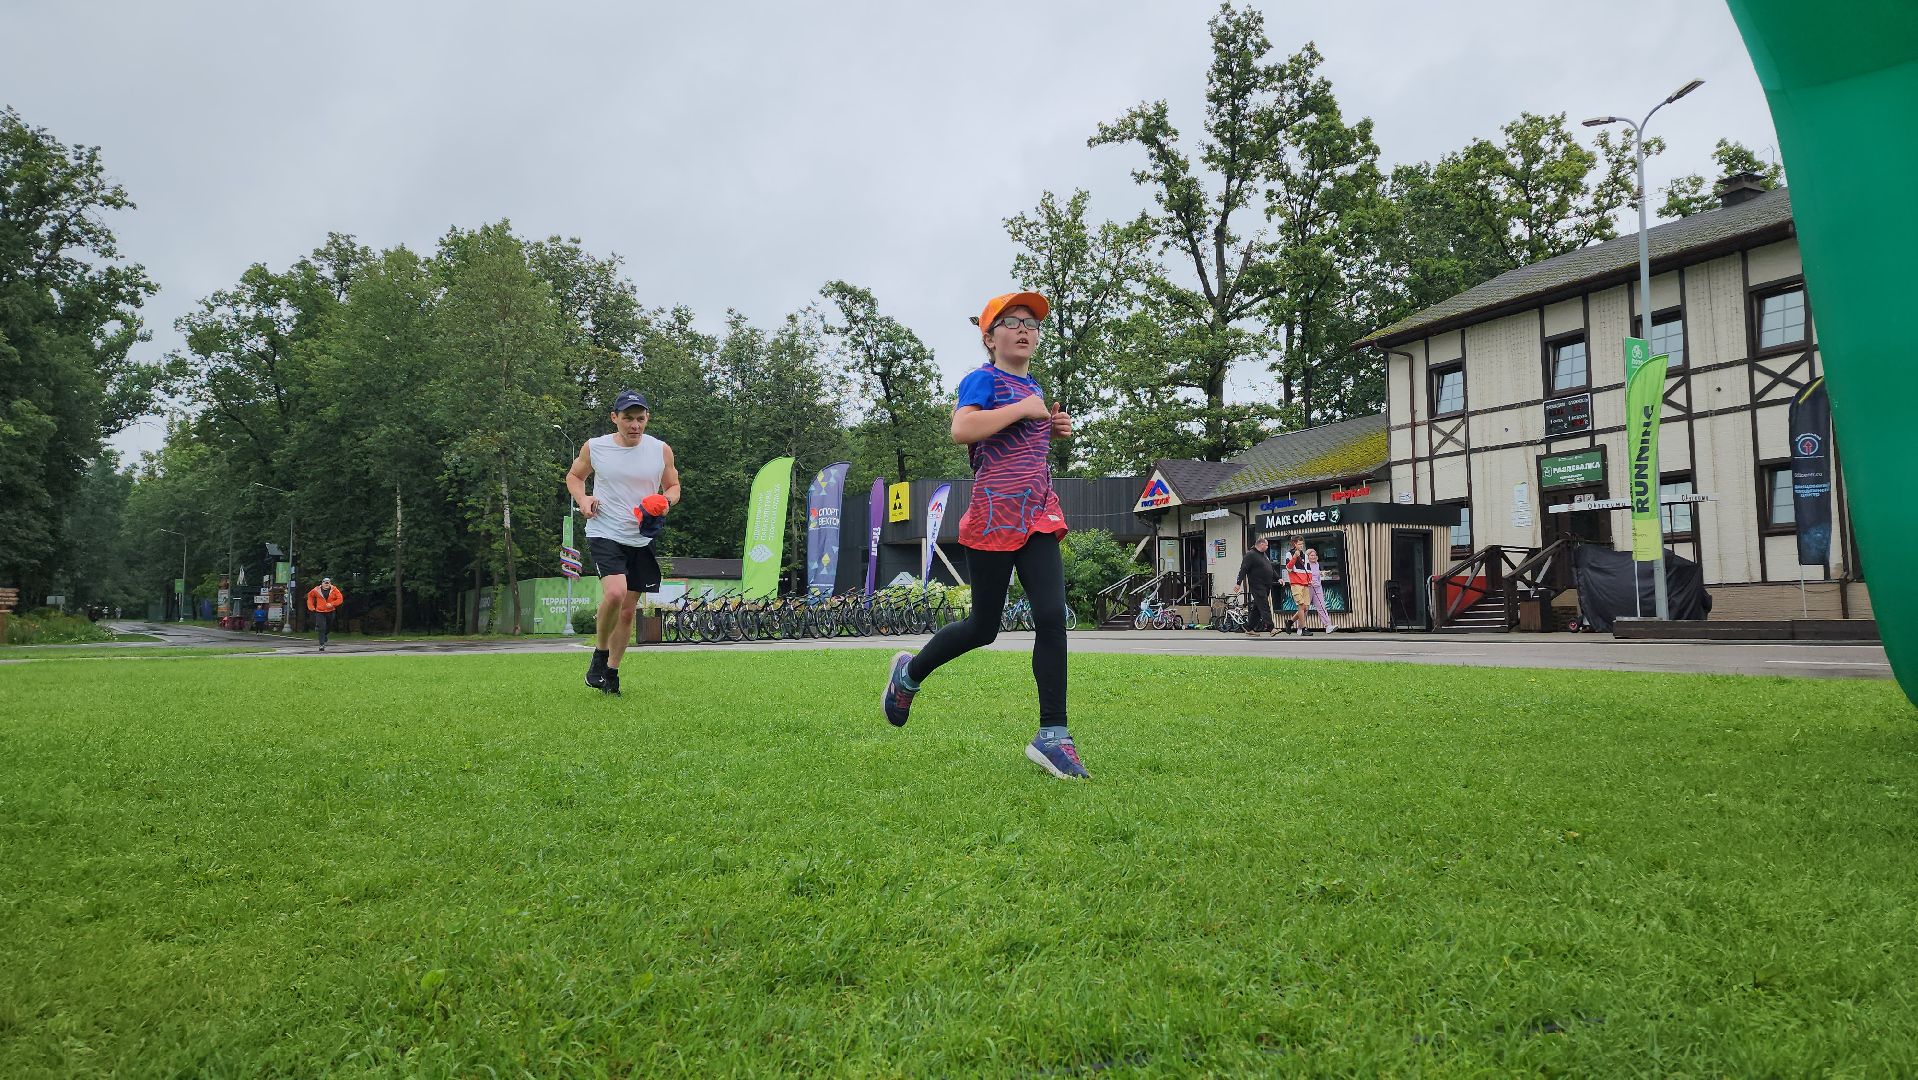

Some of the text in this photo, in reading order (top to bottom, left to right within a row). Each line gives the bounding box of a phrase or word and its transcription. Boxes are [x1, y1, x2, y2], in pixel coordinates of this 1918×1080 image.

[1634, 404, 1654, 513] RUNNING
[1552, 461, 1601, 474] РАЗДЕВАЛКА
[818, 507, 839, 516] СПОРТ
[1265, 509, 1326, 528] MAKE coffee
[550, 605, 579, 613] СПОТА
